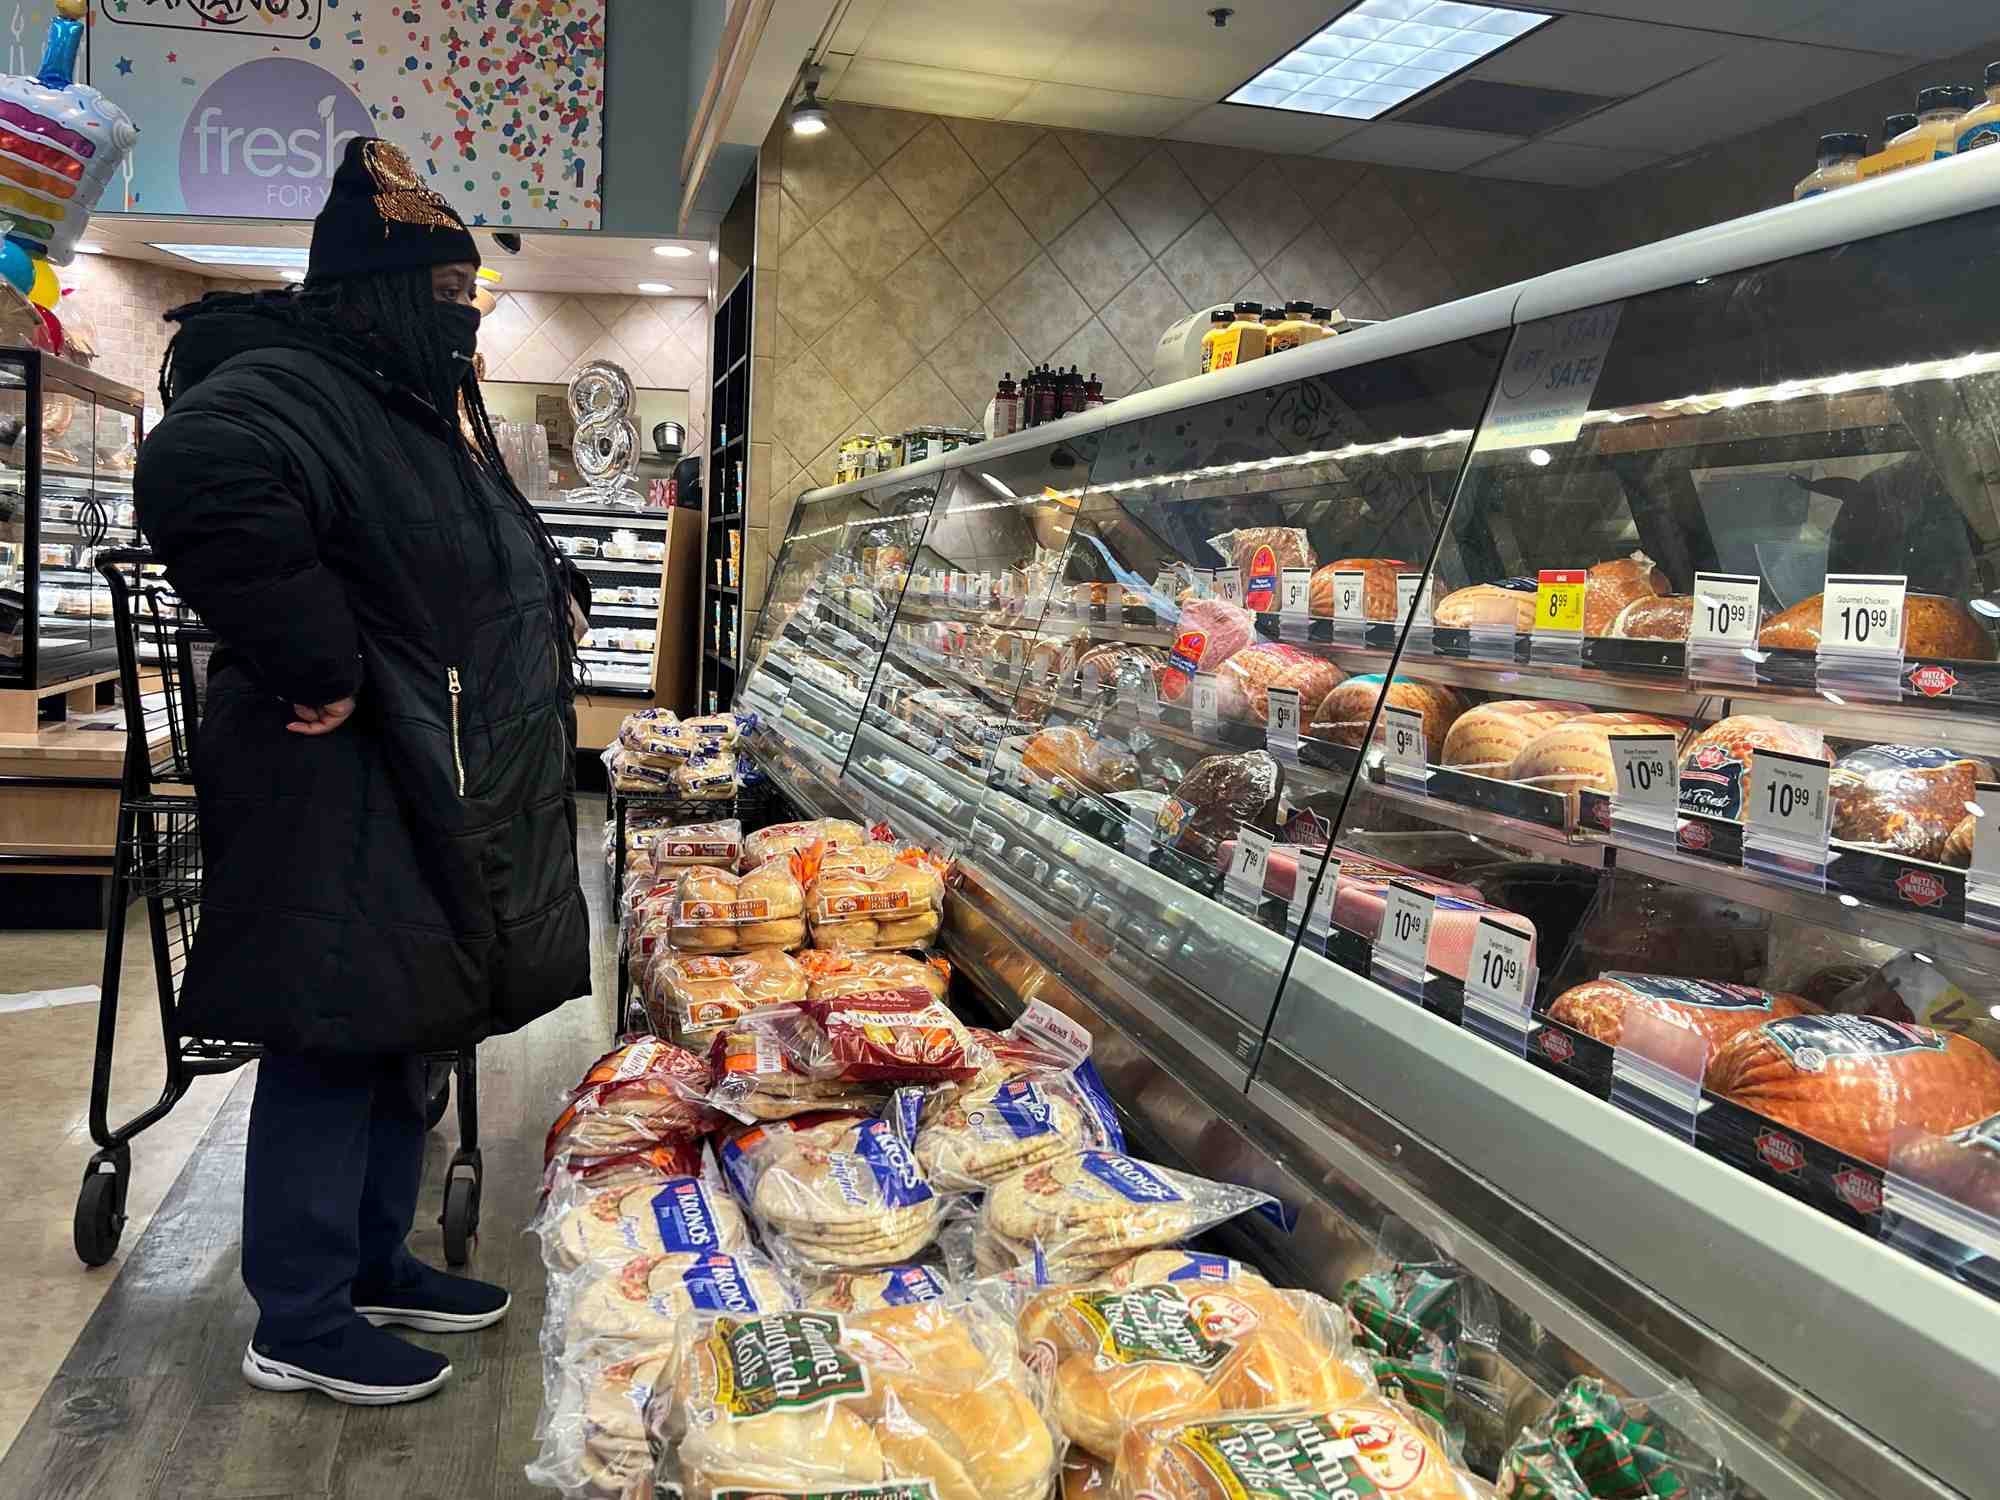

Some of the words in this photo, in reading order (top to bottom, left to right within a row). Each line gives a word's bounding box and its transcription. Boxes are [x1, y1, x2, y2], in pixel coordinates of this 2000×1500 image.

[193, 95, 361, 178] fresh
[267, 184, 312, 208] FOR
[1545, 355, 1602, 389] SAFE
[875, 1134, 921, 1189] KROS
[1106, 1157, 1171, 1200] KRONOS
[677, 1193, 712, 1245] KRONOS
[711, 1267, 749, 1311] KRONO
[735, 1332, 759, 1387] Rolls
[761, 1313, 811, 1396] ndwich
[1288, 1418, 1360, 1500] ourme
